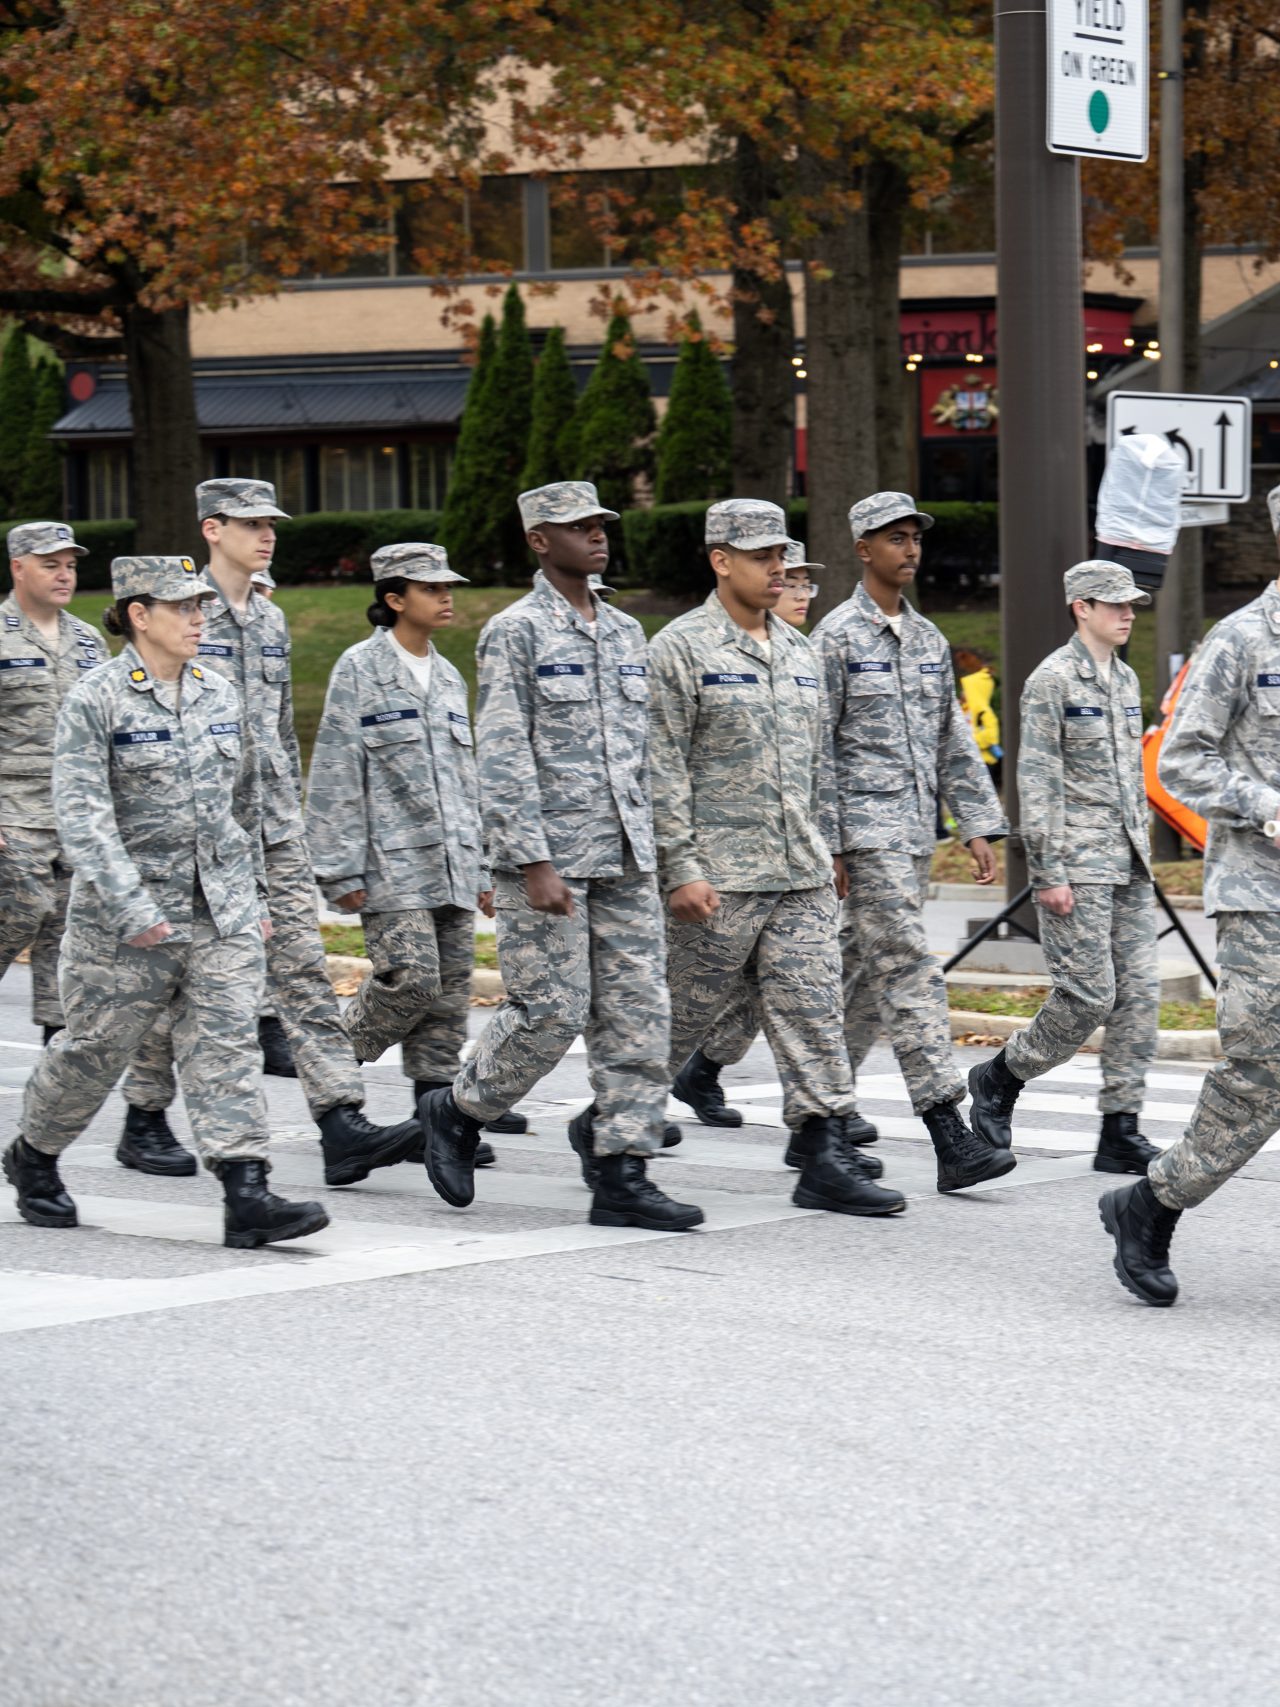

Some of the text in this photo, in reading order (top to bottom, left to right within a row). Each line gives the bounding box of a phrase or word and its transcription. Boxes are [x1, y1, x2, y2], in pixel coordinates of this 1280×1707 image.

[1074, 0, 1126, 32] YIELD
[1061, 50, 1137, 86] ON GREEN
